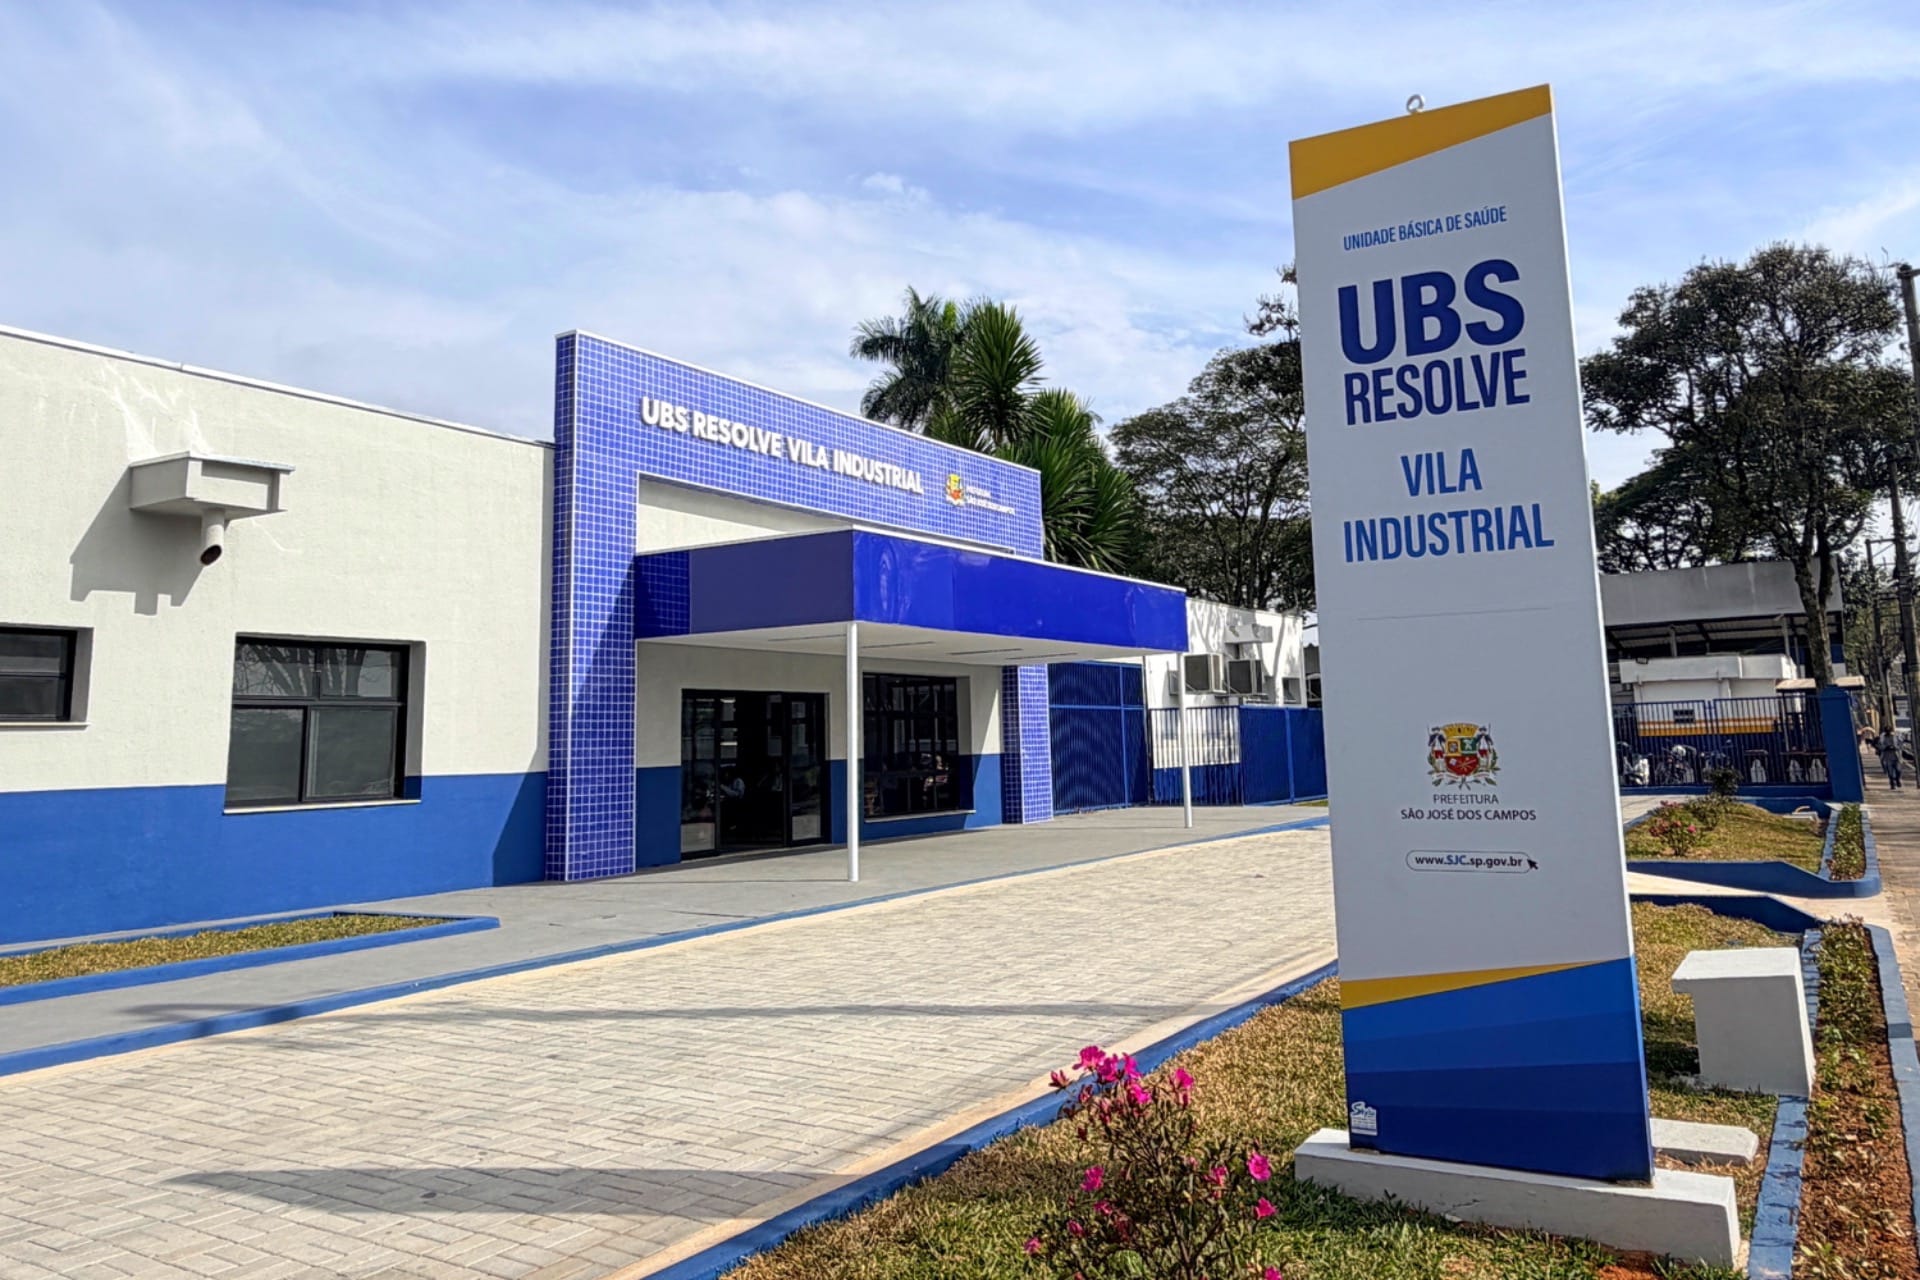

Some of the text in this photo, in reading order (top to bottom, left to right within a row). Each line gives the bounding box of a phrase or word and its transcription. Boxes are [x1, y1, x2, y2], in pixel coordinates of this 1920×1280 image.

[1343, 206, 1507, 250] UNIDADE BÁSICA DE SAÚDE
[1338, 258, 1525, 365] UBS
[1344, 348, 1530, 426] RESOLVE
[641, 396, 924, 494] UBS RESOLVE VILA INDUSTRIAL
[1400, 448, 1483, 497] VILA
[1343, 503, 1555, 563] INDUSTRIAL
[1400, 807, 1537, 821] SÃO JOSÉ DOS CAMPOS
[1433, 794, 1499, 805] PREFEITURA
[1415, 854, 1523, 869] www.SJC.sp.gov.br
